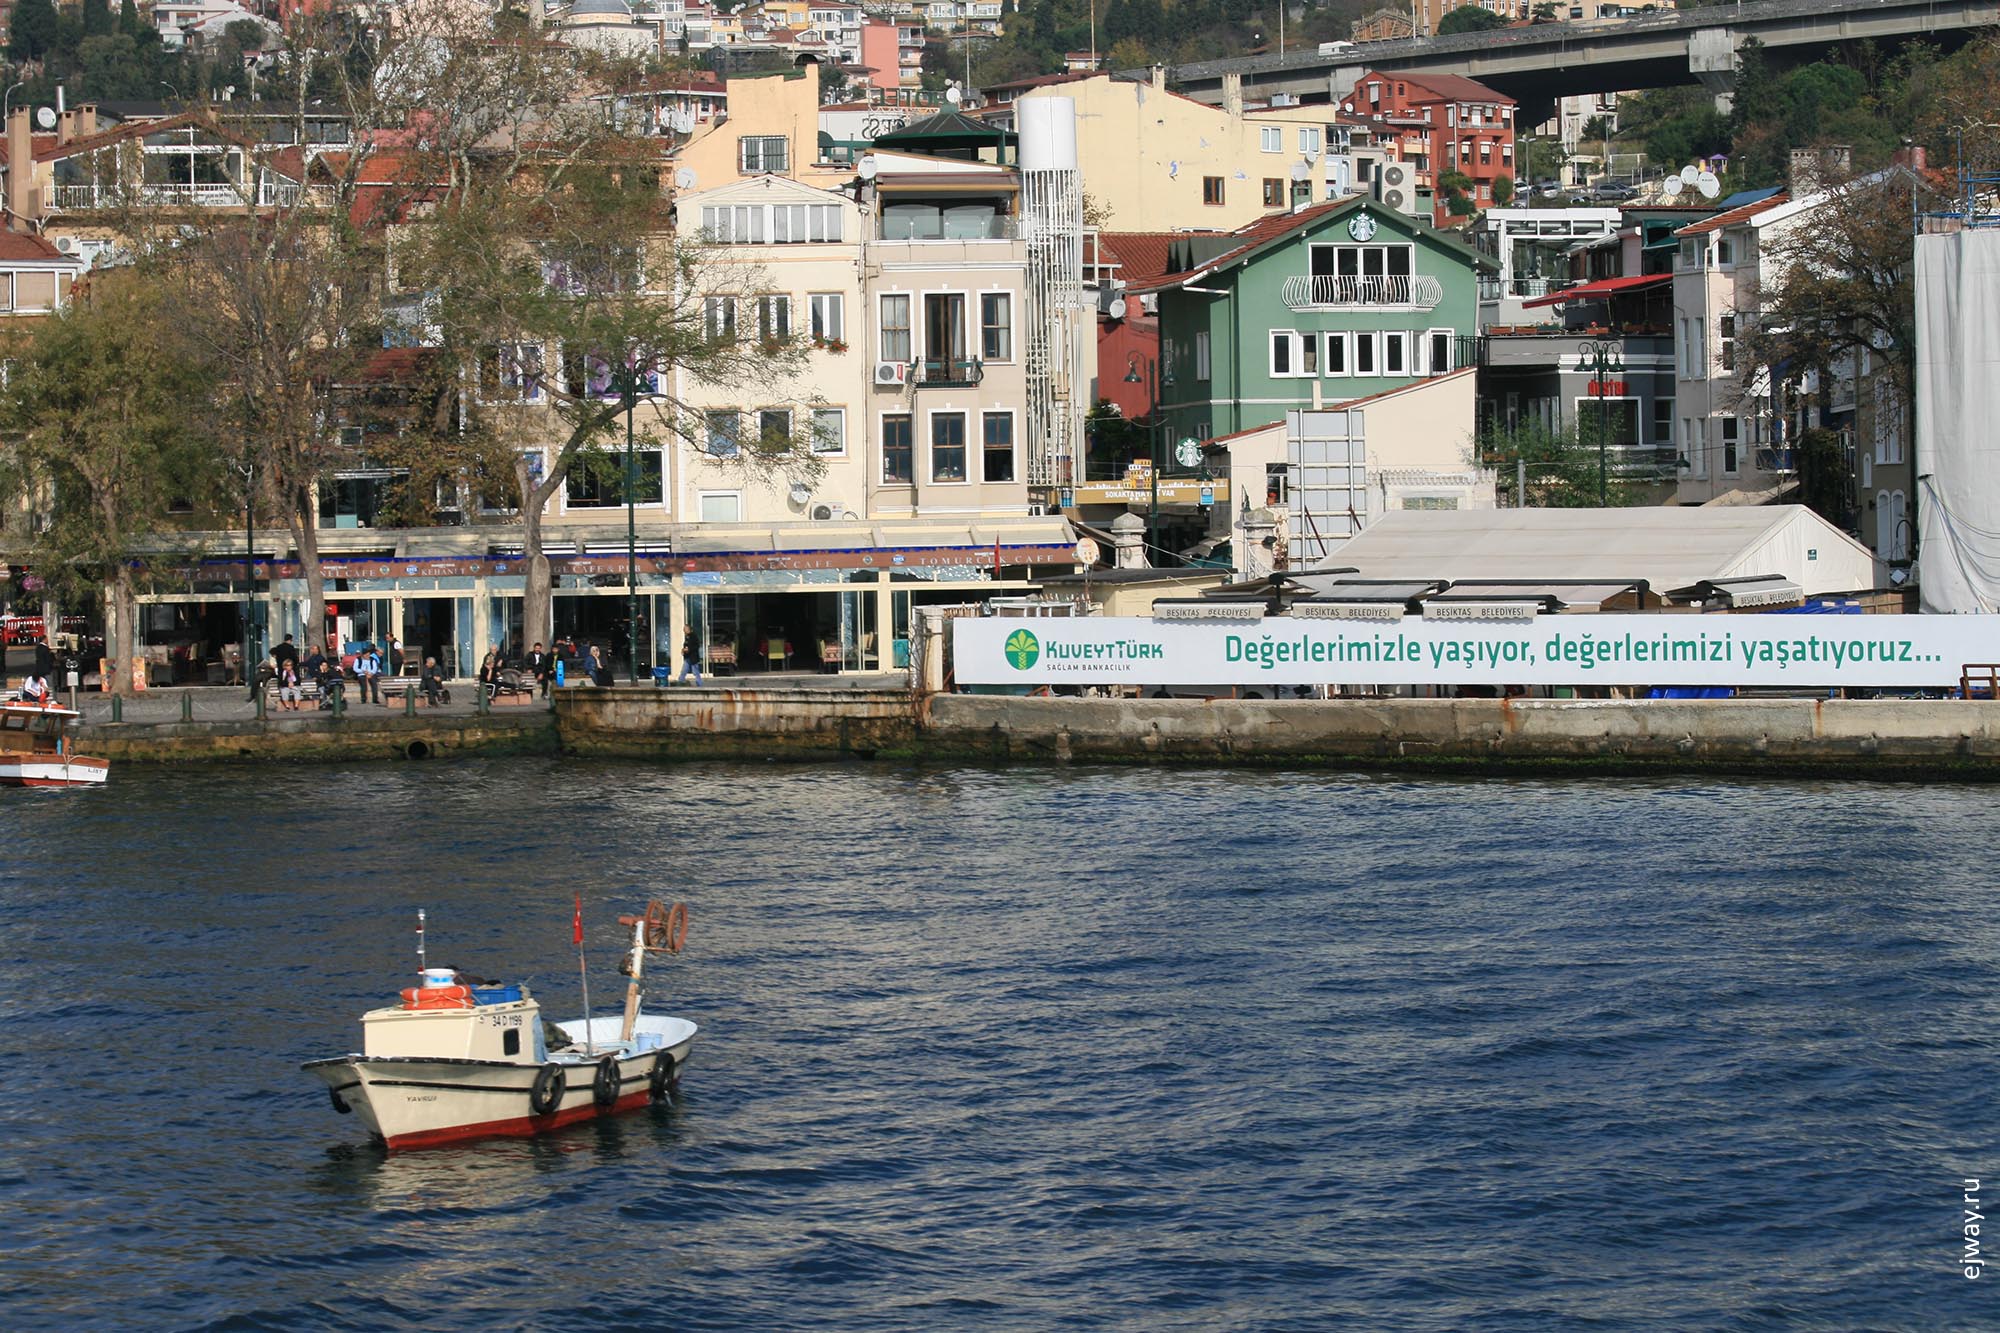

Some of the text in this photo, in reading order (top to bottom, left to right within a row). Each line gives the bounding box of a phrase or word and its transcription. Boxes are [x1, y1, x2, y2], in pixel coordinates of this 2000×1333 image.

[1161, 489, 1175, 497] VAR
[1014, 554, 1054, 563] CAFE
[618, 564, 641, 572] PB
[793, 560, 833, 569] CAFE
[345, 569, 377, 577] CAFE
[1225, 632, 1942, 670] Değerlerimizle yaşıyor, değerlerimizi yaşatıyoruz...
[1047, 663, 1131, 671] SAĞLAM BANKACILIK
